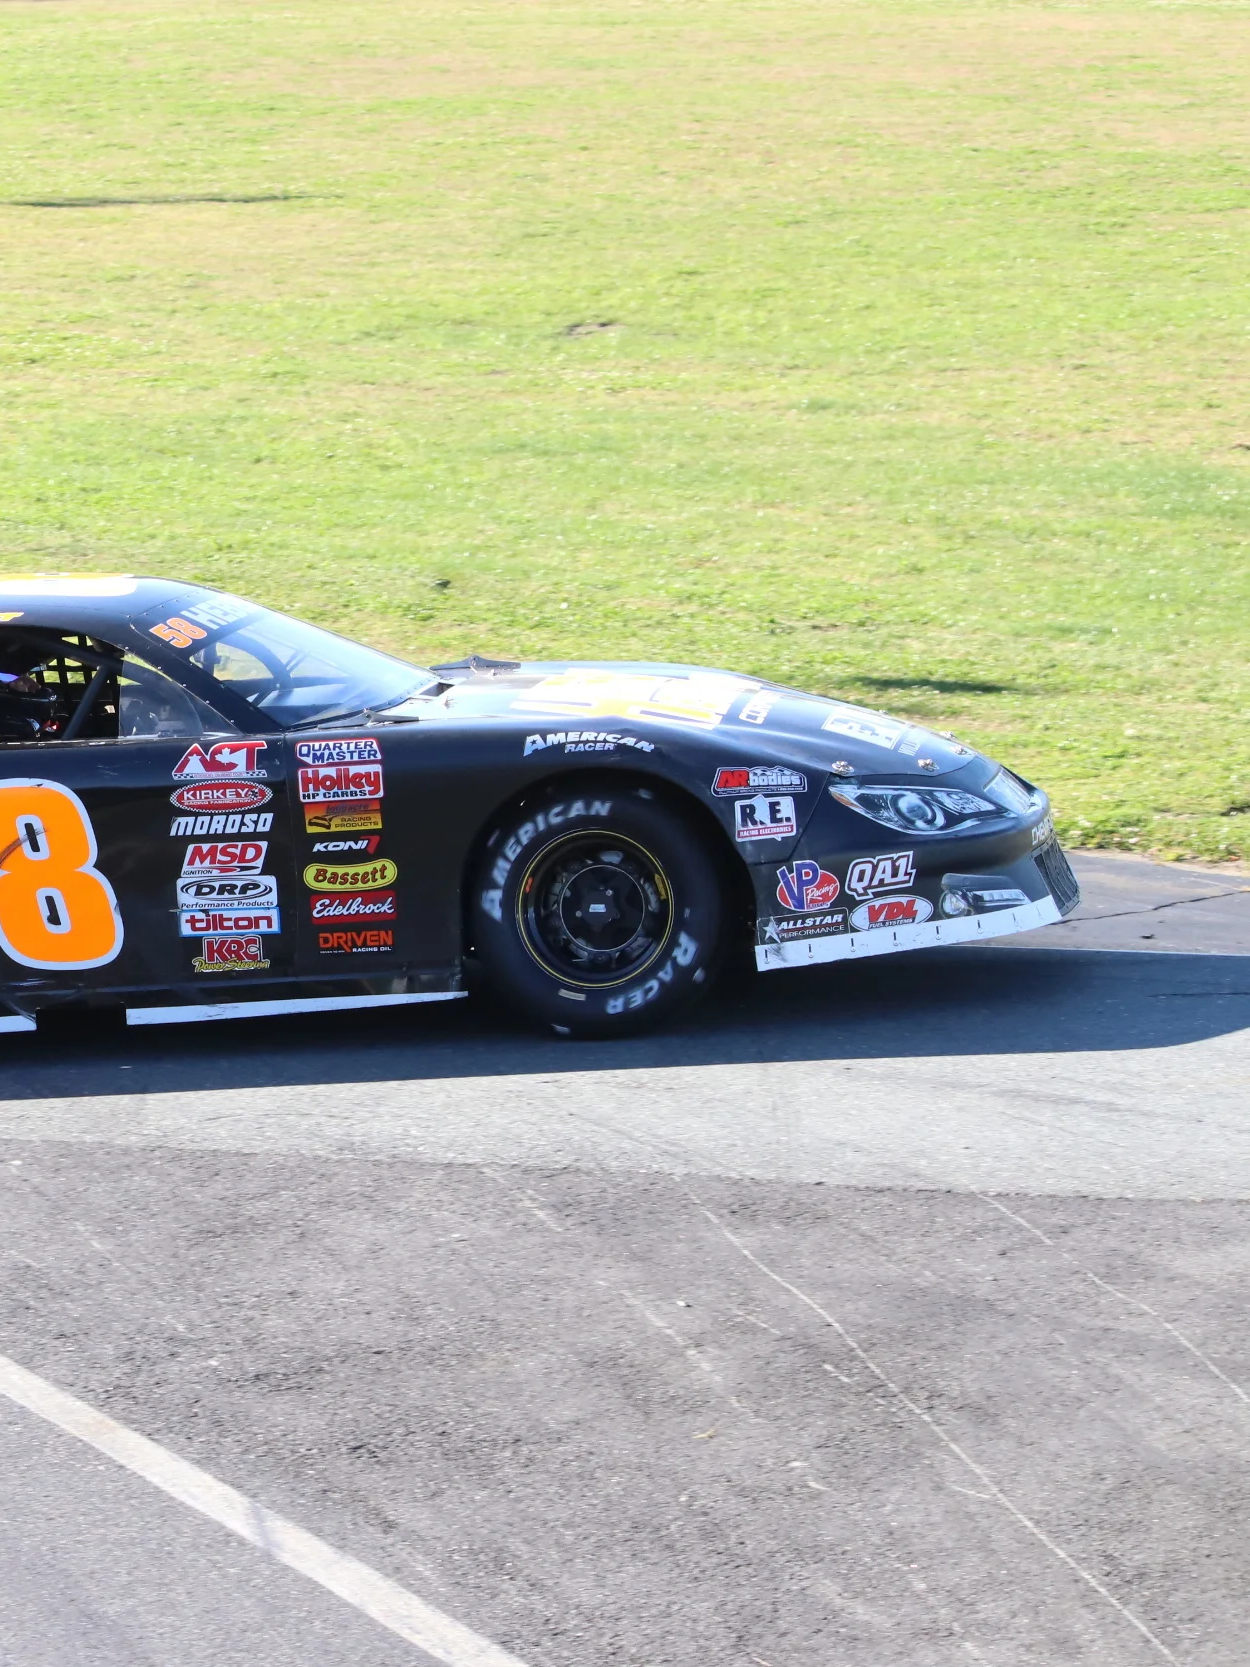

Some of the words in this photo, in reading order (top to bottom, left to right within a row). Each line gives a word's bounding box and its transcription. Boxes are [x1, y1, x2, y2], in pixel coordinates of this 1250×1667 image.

[148, 617, 208, 648] 58
[298, 740, 375, 758] QUARTER
[523, 731, 655, 757] AMERICAN
[565, 743, 615, 754] RACER
[172, 741, 268, 774] ACT
[312, 750, 379, 764] MASTER
[300, 767, 382, 796] Holley
[183, 788, 249, 800] KIRKEY
[323, 790, 368, 799] CARBS
[169, 812, 274, 836] MOROSO
[335, 821, 379, 829] PRODUCTS
[739, 829, 759, 837] RACING
[759, 825, 792, 835] ELECTRONICS
[186, 843, 263, 867] MSD
[312, 839, 369, 852] KONI
[481, 800, 613, 922] AMERICAN
[313, 864, 388, 886] Bassett
[776, 860, 821, 911] VP
[846, 852, 915, 899] QA1
[193, 882, 262, 897] DRP
[806, 882, 839, 903] Racing
[181, 901, 235, 909] Performance
[237, 900, 274, 908] Products
[312, 897, 395, 918] Edelbrock
[867, 899, 919, 923] VDL
[185, 913, 273, 932] tilton
[779, 914, 845, 931] ALLSTAR
[779, 924, 845, 939] PERFORMANCE
[885, 919, 913, 927] SYSTEMS
[204, 935, 262, 963] KRC
[319, 930, 394, 952] DRIVEN
[192, 957, 225, 972] Power
[225, 957, 270, 971] Steering
[605, 931, 699, 1014] RACER
